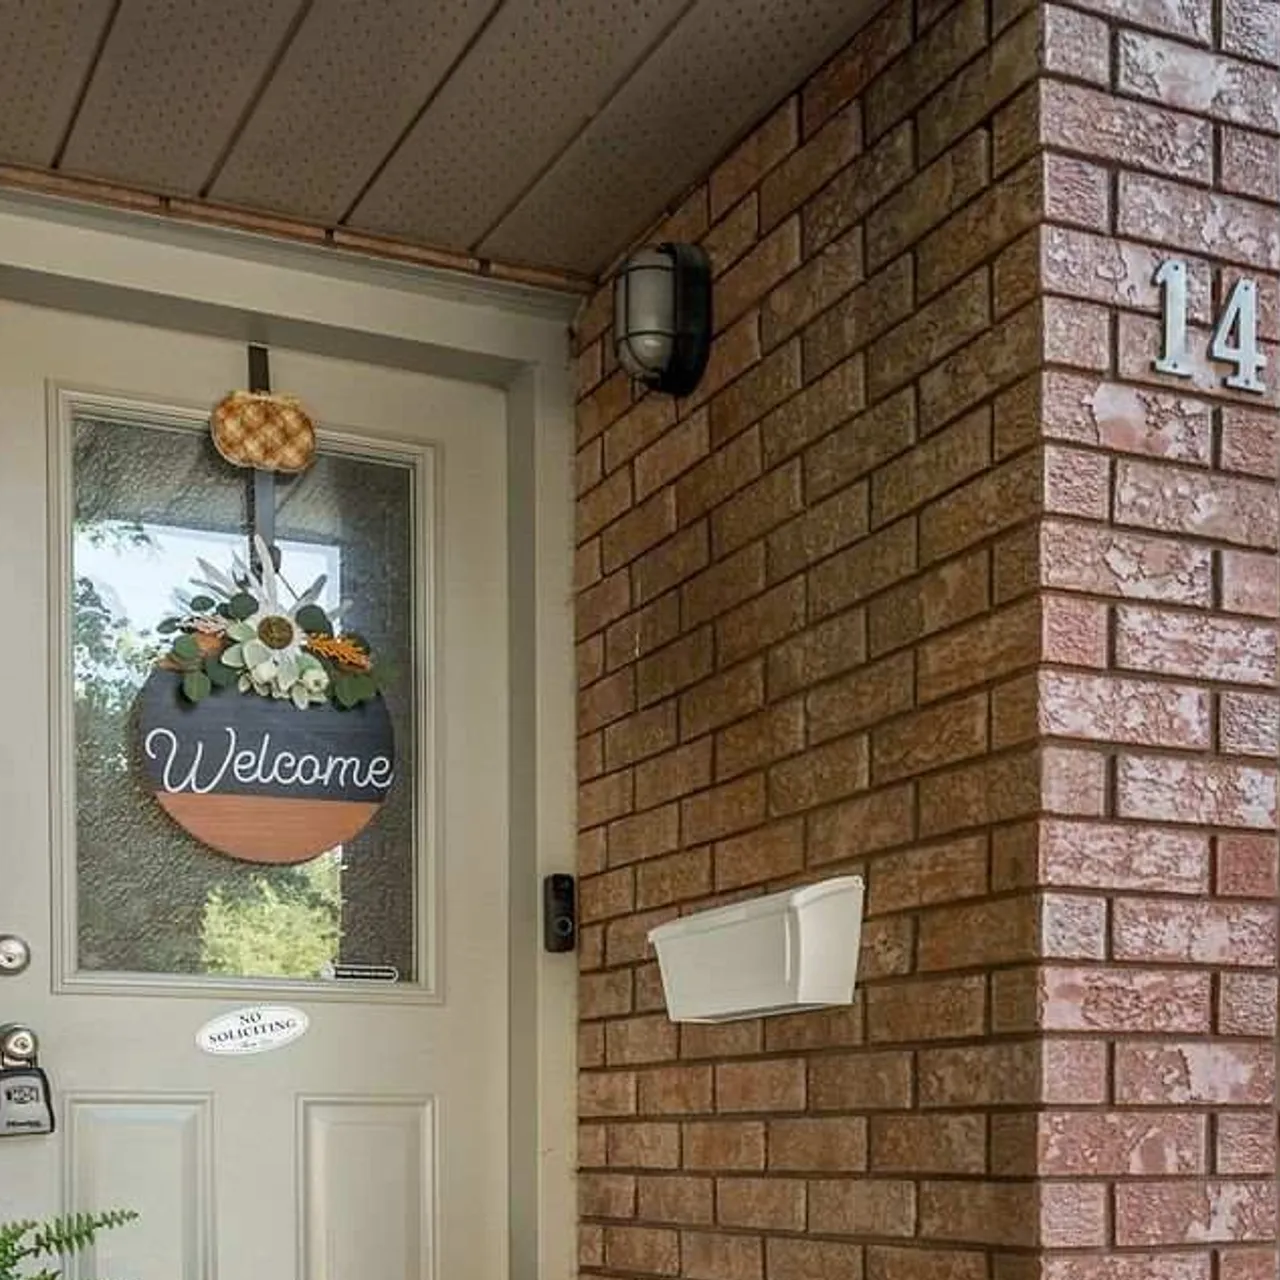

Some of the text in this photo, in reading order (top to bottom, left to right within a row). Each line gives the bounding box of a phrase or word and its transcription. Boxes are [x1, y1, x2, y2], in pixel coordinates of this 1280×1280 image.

[1153, 260, 1268, 393] 14
[144, 727, 395, 794] Welcome
[208, 1018, 298, 1043] SOLICITING
[240, 1011, 262, 1026] NO
